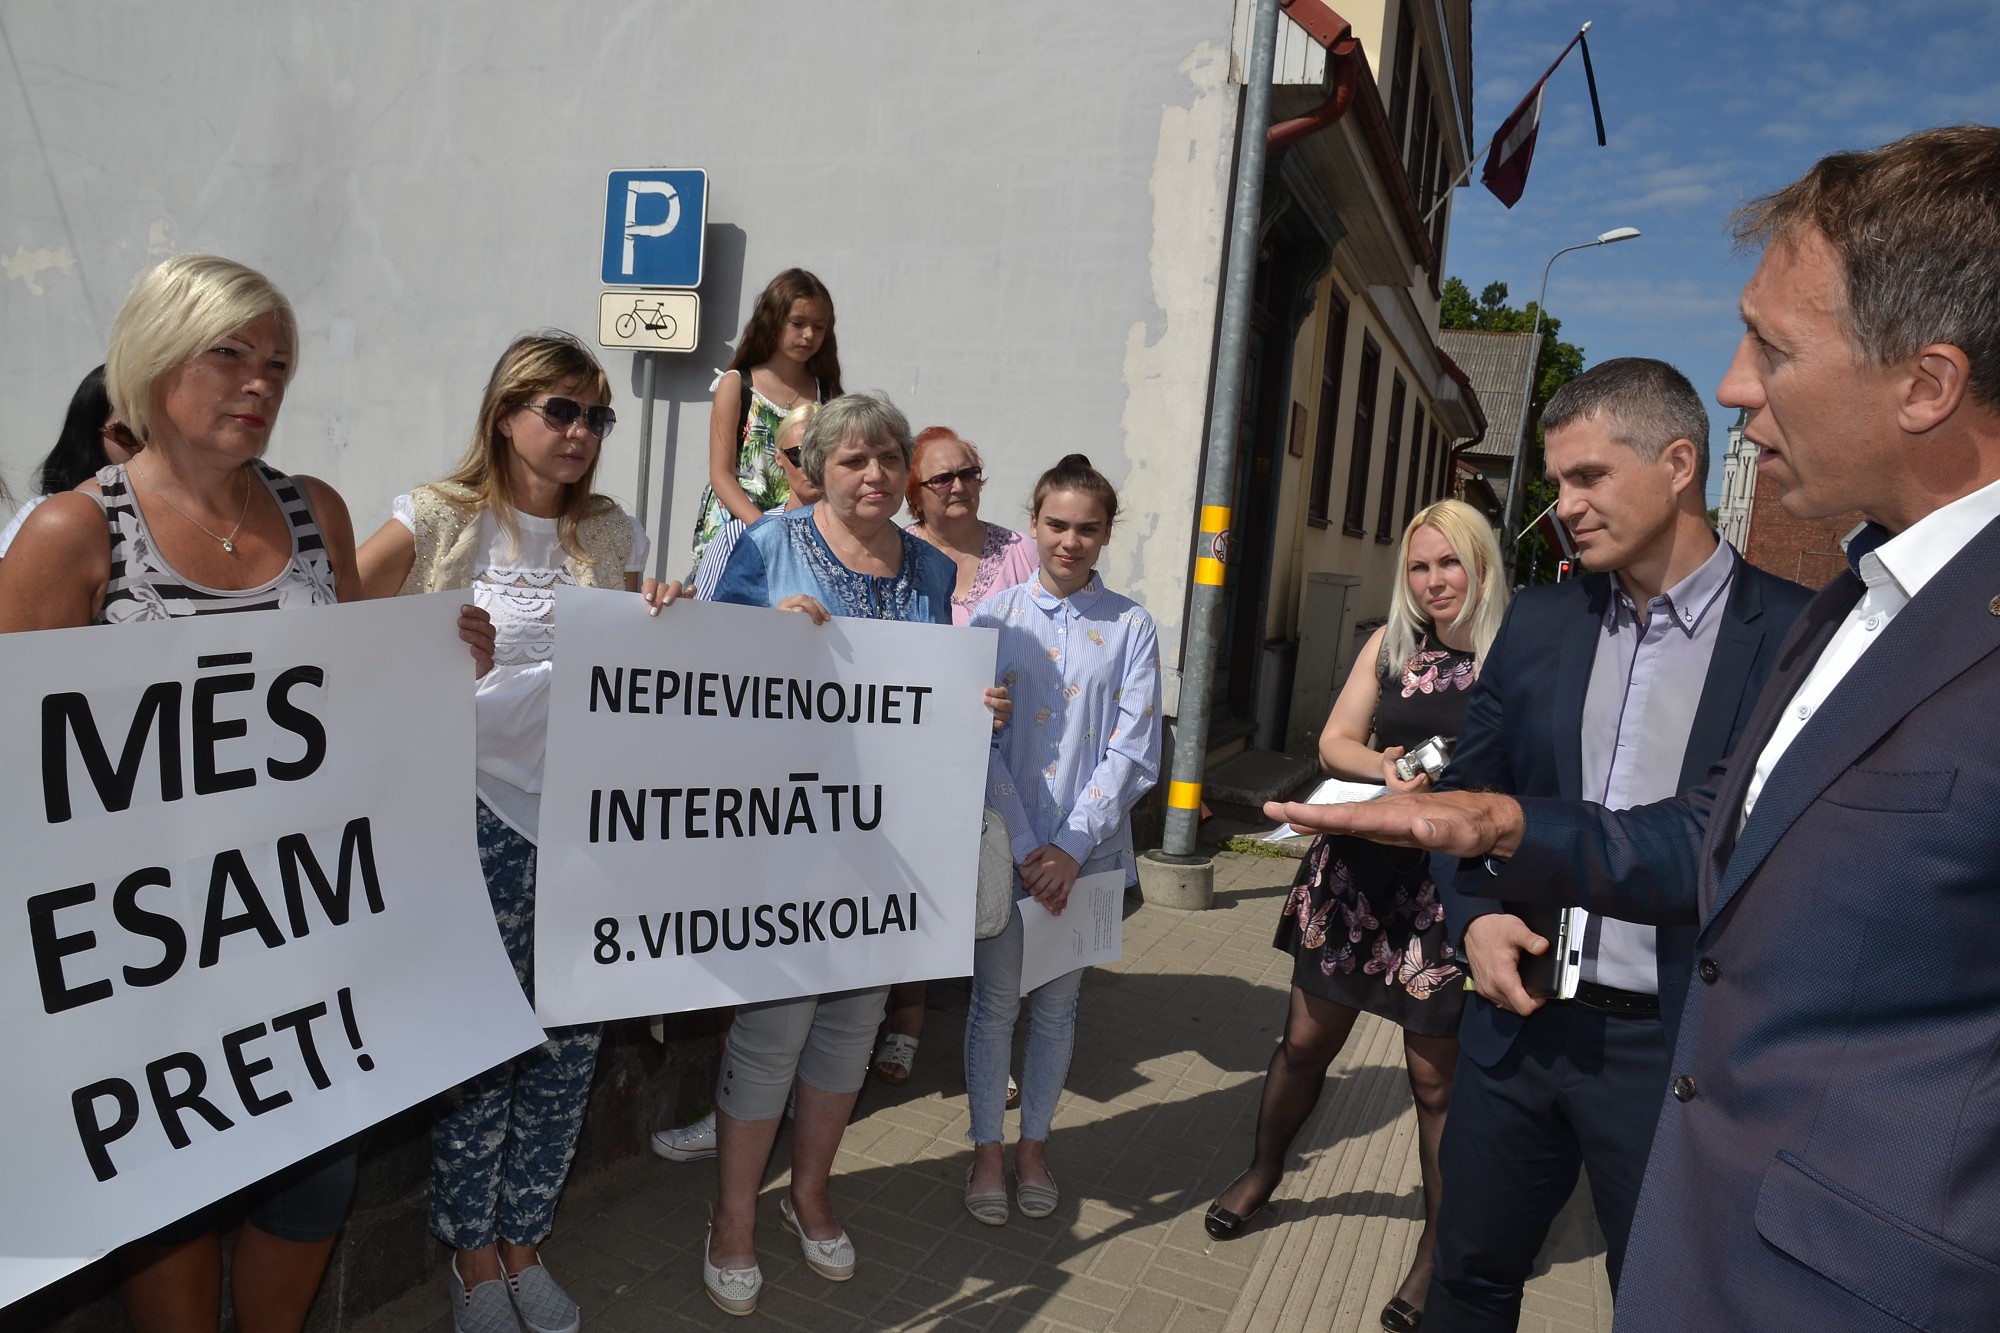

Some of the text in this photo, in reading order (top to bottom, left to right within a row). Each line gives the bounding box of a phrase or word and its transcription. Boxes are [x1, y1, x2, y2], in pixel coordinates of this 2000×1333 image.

[621, 180, 680, 275] P
[40, 650, 329, 824] MĒS
[588, 664, 934, 726] NEPIEVIENOJIET
[588, 771, 883, 844] INTERNĀTU
[25, 815, 387, 1016] ESAM
[592, 891, 919, 966] 8.VIDUSSKOLAI
[70, 986, 376, 1184] PRET!
